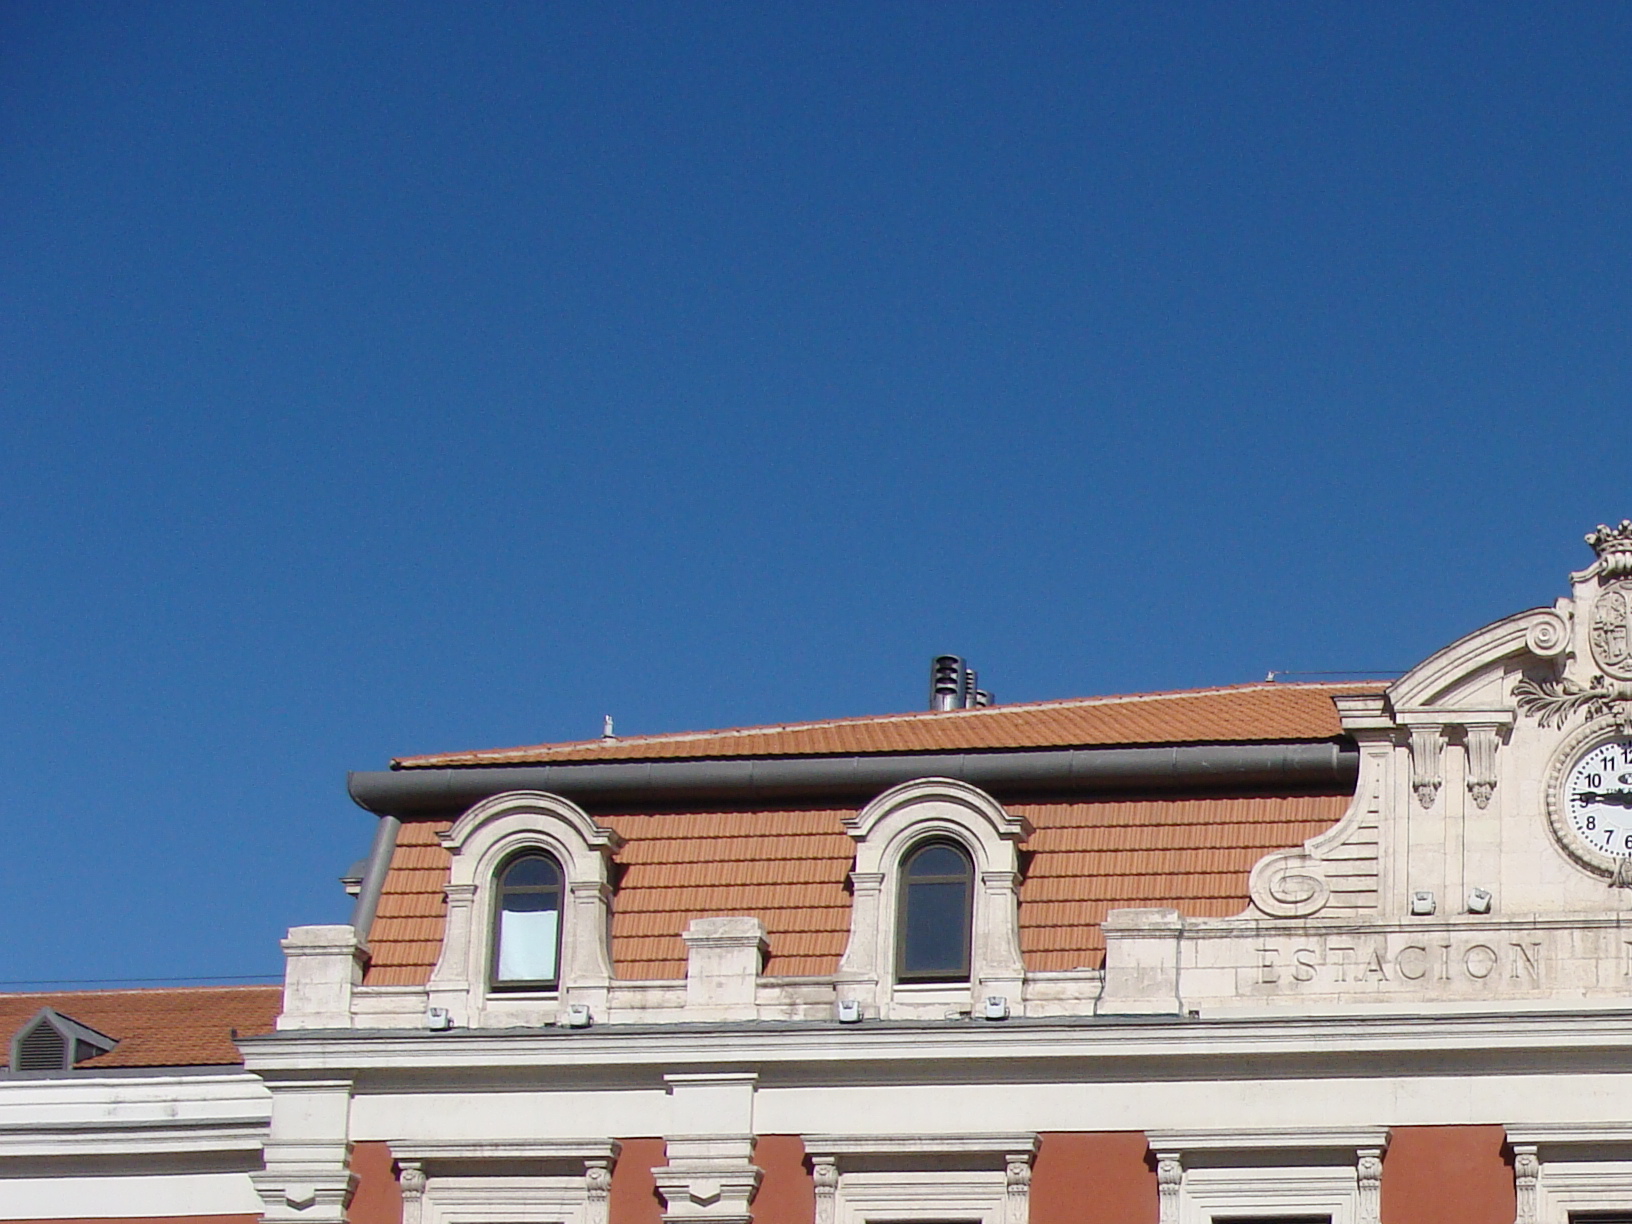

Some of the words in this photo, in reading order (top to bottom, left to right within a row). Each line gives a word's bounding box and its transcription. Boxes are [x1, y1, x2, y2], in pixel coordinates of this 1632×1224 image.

[1600, 756, 1615, 771] 11
[1584, 773, 1601, 788] 10
[1586, 816, 1596, 830] 8
[1604, 830, 1614, 845] 7
[1254, 942, 1541, 985] ESTACION
